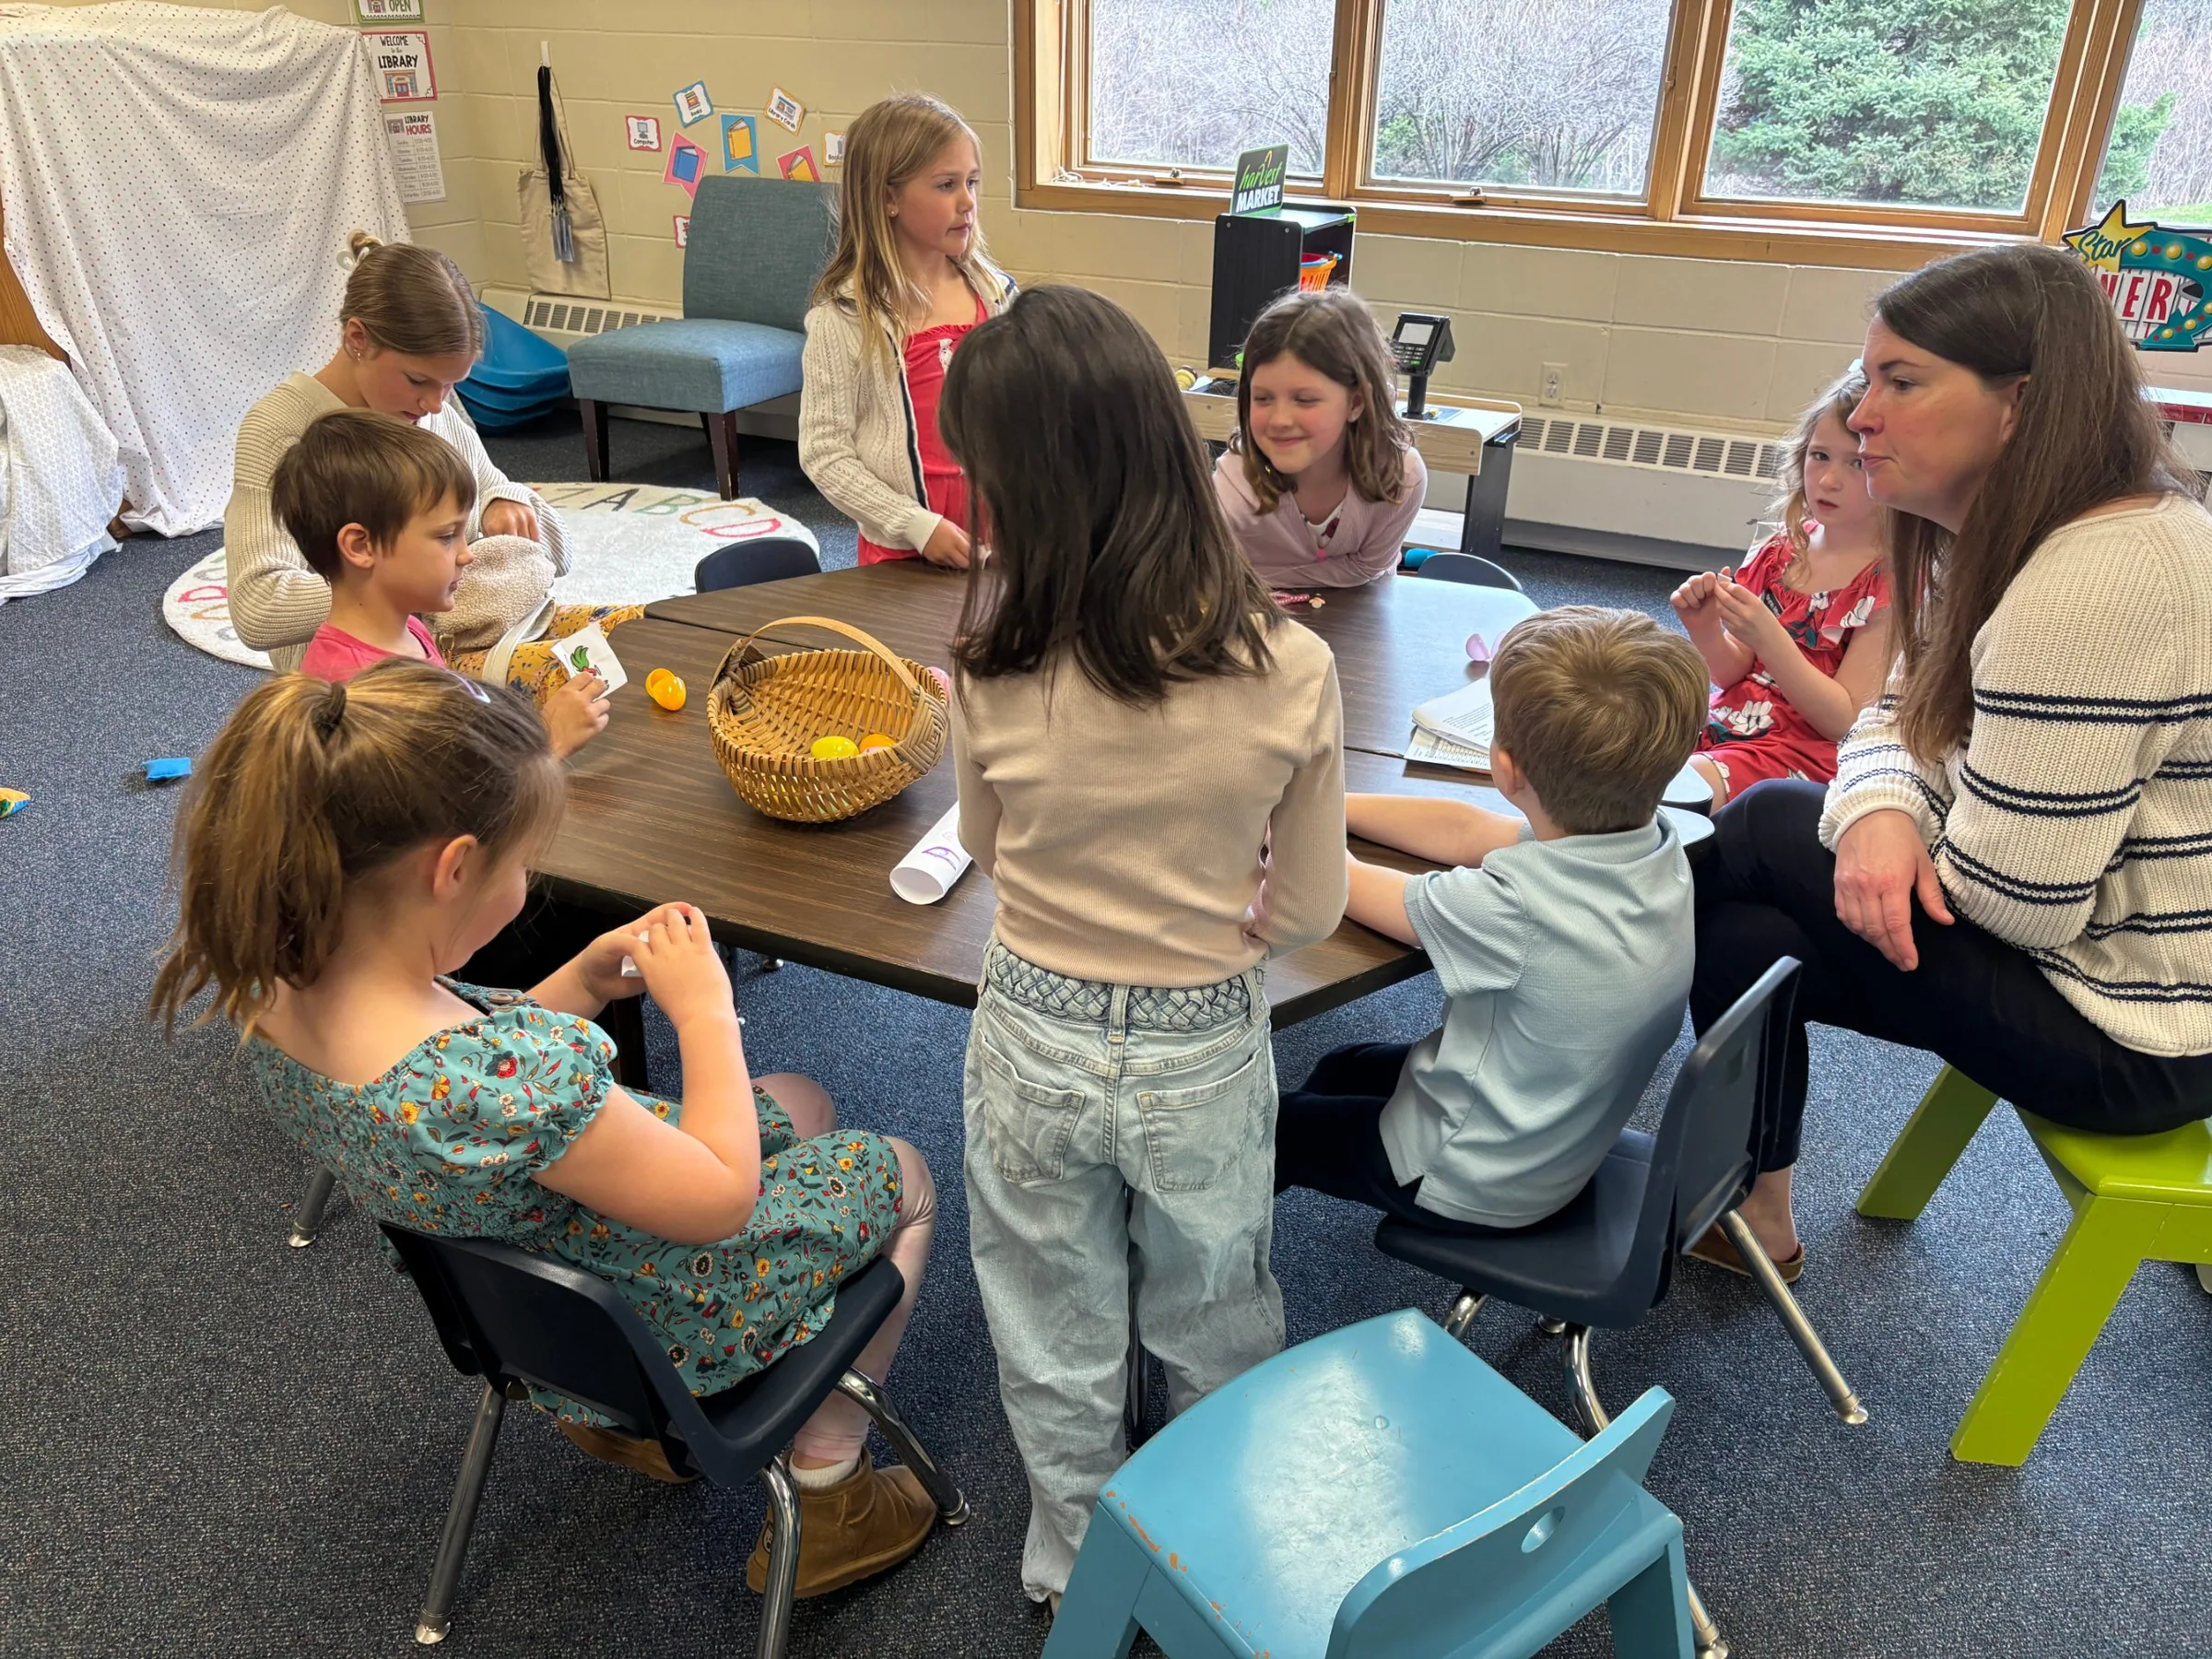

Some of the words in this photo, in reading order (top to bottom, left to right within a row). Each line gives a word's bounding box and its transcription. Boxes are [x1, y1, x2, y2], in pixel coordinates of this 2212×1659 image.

[389, 0, 411, 12] OPEN
[380, 35, 408, 46] WELCOME
[378, 54, 418, 68] LIBRARY
[405, 114, 429, 124] LIBRARY
[406, 124, 432, 135] HOURS
[1239, 150, 1283, 192] harvest
[1236, 184, 1280, 213] MARKET
[2077, 229, 2133, 263] Star
[2100, 274, 2172, 321] NER
